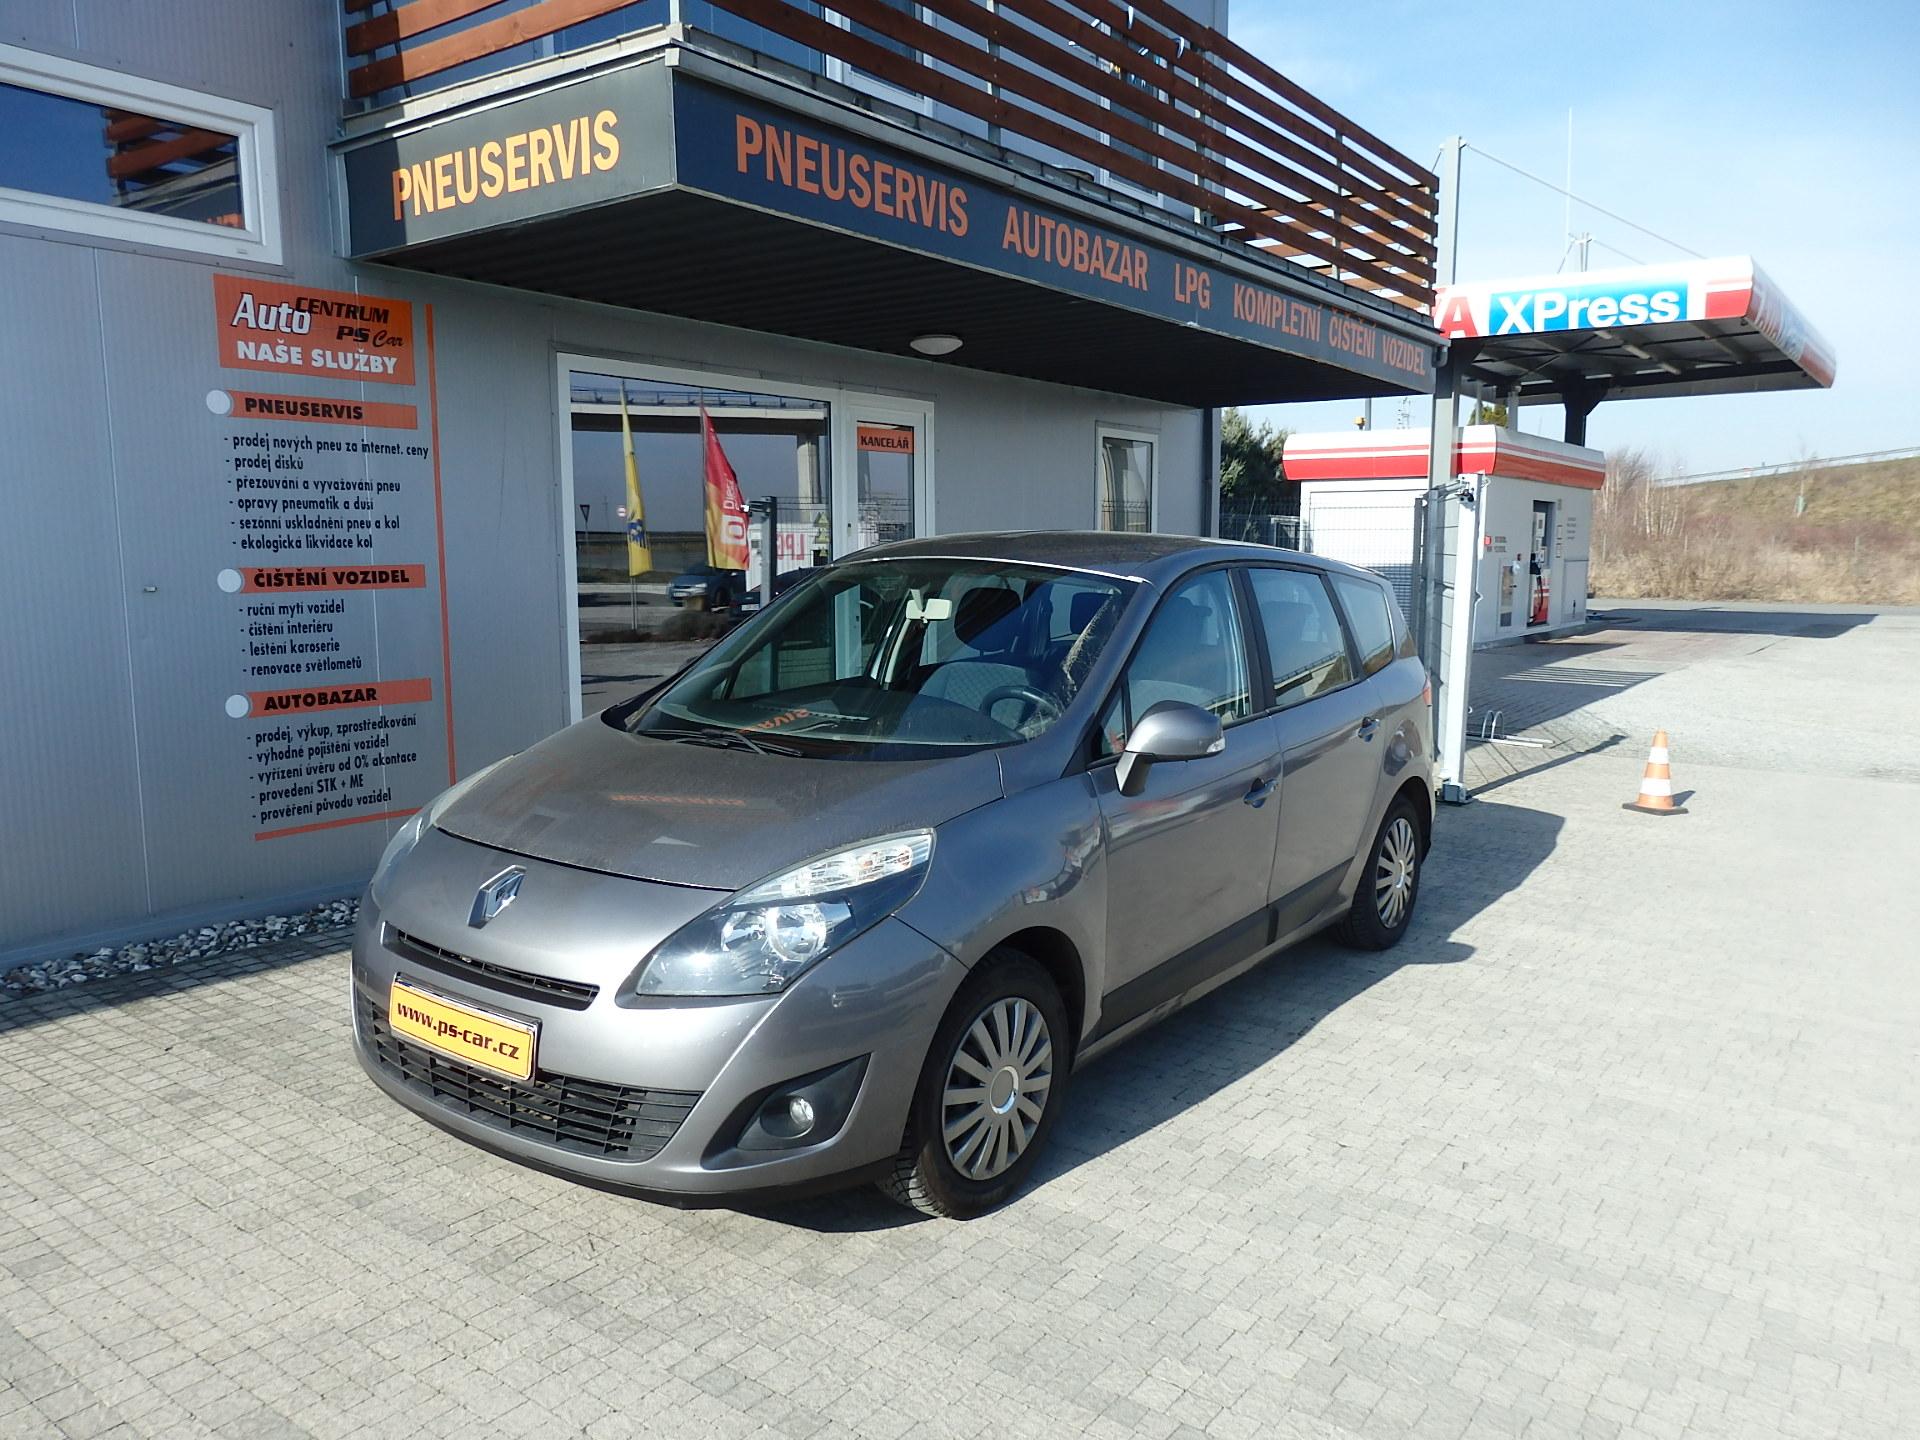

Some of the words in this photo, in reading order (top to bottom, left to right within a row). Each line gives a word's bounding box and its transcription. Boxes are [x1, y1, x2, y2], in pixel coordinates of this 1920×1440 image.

[392, 110, 620, 222] PNEUSERVIS
[736, 114, 969, 238] PNEUSERVIS
[1002, 206, 1148, 292] AUTOBAZAR
[1174, 263, 1210, 311] LPG
[1233, 283, 1323, 342] KOMPLETNÍ
[1328, 307, 1377, 360] ČIŠTĚNÍ
[1382, 335, 1426, 376] VOZIDEL
[231, 292, 312, 335] Auto
[296, 297, 389, 323] CENTRUM
[1496, 290, 1680, 335] XPress
[336, 326, 371, 343] PS
[372, 329, 404, 347] Car
[237, 338, 303, 365] NAŠE
[312, 347, 398, 375] SLUŽBY
[245, 397, 363, 420] PNEUSERVIS
[233, 433, 270, 452] prodej
[273, 435, 313, 453] nových
[316, 440, 342, 453] pneu
[346, 442, 358, 452] za
[361, 439, 404, 456] internet.
[407, 446, 429, 460] ceny
[860, 435, 909, 449] KANCELÁŘ
[235, 453, 271, 472] prodej
[275, 454, 304, 470] disků
[236, 475, 299, 492] přezouvání
[303, 480, 309, 490] a
[313, 478, 374, 494] vyvažování
[377, 482, 400, 494] pneu
[237, 498, 278, 513] opravy
[282, 496, 340, 513] pneumatik
[344, 499, 350, 510] a
[240, 516, 281, 530] sezónní
[285, 515, 344, 530] uskladnění
[347, 518, 372, 532] pneu
[375, 519, 381, 530] a
[384, 515, 400, 530] kol
[241, 534, 302, 553] ekologická
[306, 534, 353, 549] likvidace
[356, 534, 373, 549] kol
[254, 568, 327, 587] ČIŠTĚNÍ
[332, 569, 410, 585] VOZIDEL
[247, 602, 275, 617] ruční
[279, 602, 304, 618] mytí
[307, 599, 345, 615] vozidel
[249, 621, 284, 636] čištění
[288, 619, 333, 635] interiéru
[250, 641, 287, 657] leštění
[290, 637, 340, 655] karoserie
[252, 661, 302, 676] renovace
[305, 655, 362, 673] světlometů
[264, 688, 377, 711] AUTOBAZAR
[256, 726, 294, 747] prodej,
[297, 722, 333, 742] výkup,
[337, 713, 417, 738] zprostředkování
[257, 744, 304, 766] výhodné
[308, 740, 350, 761] pojištění
[354, 733, 389, 750] vozidel
[258, 767, 302, 786] vyřízení
[306, 762, 335, 776] úvěru
[339, 759, 351, 772] od
[355, 756, 369, 769] 0%
[372, 751, 417, 767] akontace
[259, 782, 314, 805] provedení
[317, 778, 338, 793] STK
[350, 774, 364, 789] ME
[261, 803, 313, 825] prověření
[316, 794, 353, 815] původu
[357, 788, 392, 805] vozidel
[397, 1002, 520, 1060] www.ps-car.cz
